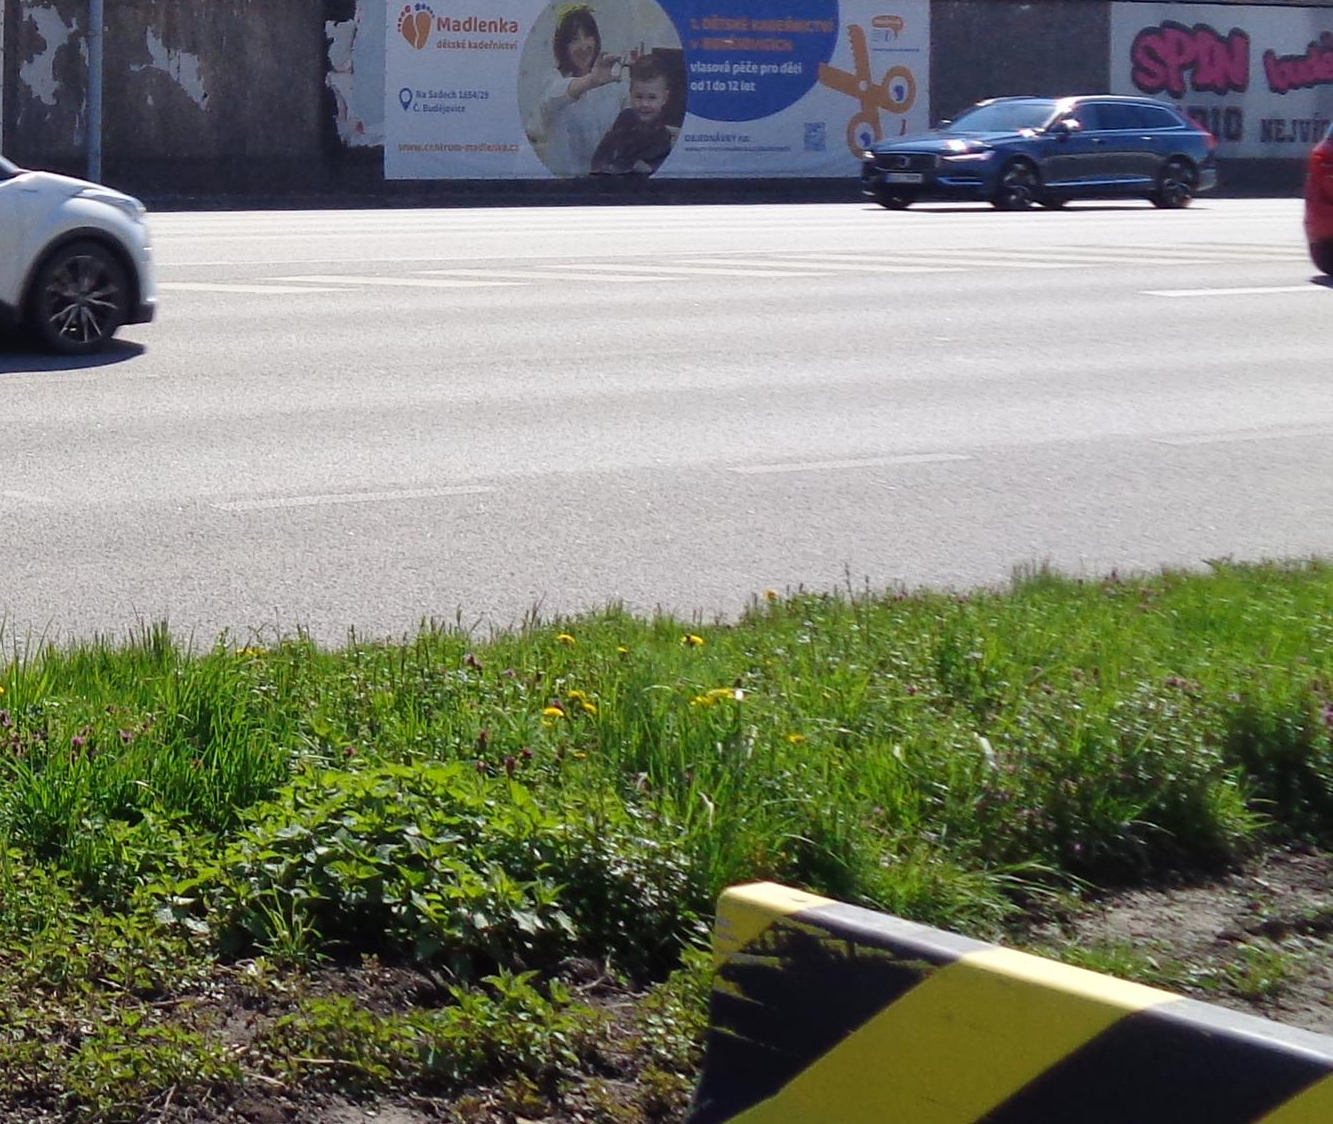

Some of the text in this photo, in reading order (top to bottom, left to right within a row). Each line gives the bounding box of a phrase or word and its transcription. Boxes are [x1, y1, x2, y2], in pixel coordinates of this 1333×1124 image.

[437, 16, 518, 33] Madlenka
[690, 60, 730, 73] vlasová
[760, 64, 778, 76] pro
[690, 81, 705, 91] od
[713, 81, 726, 91] do
[727, 81, 739, 91] 12
